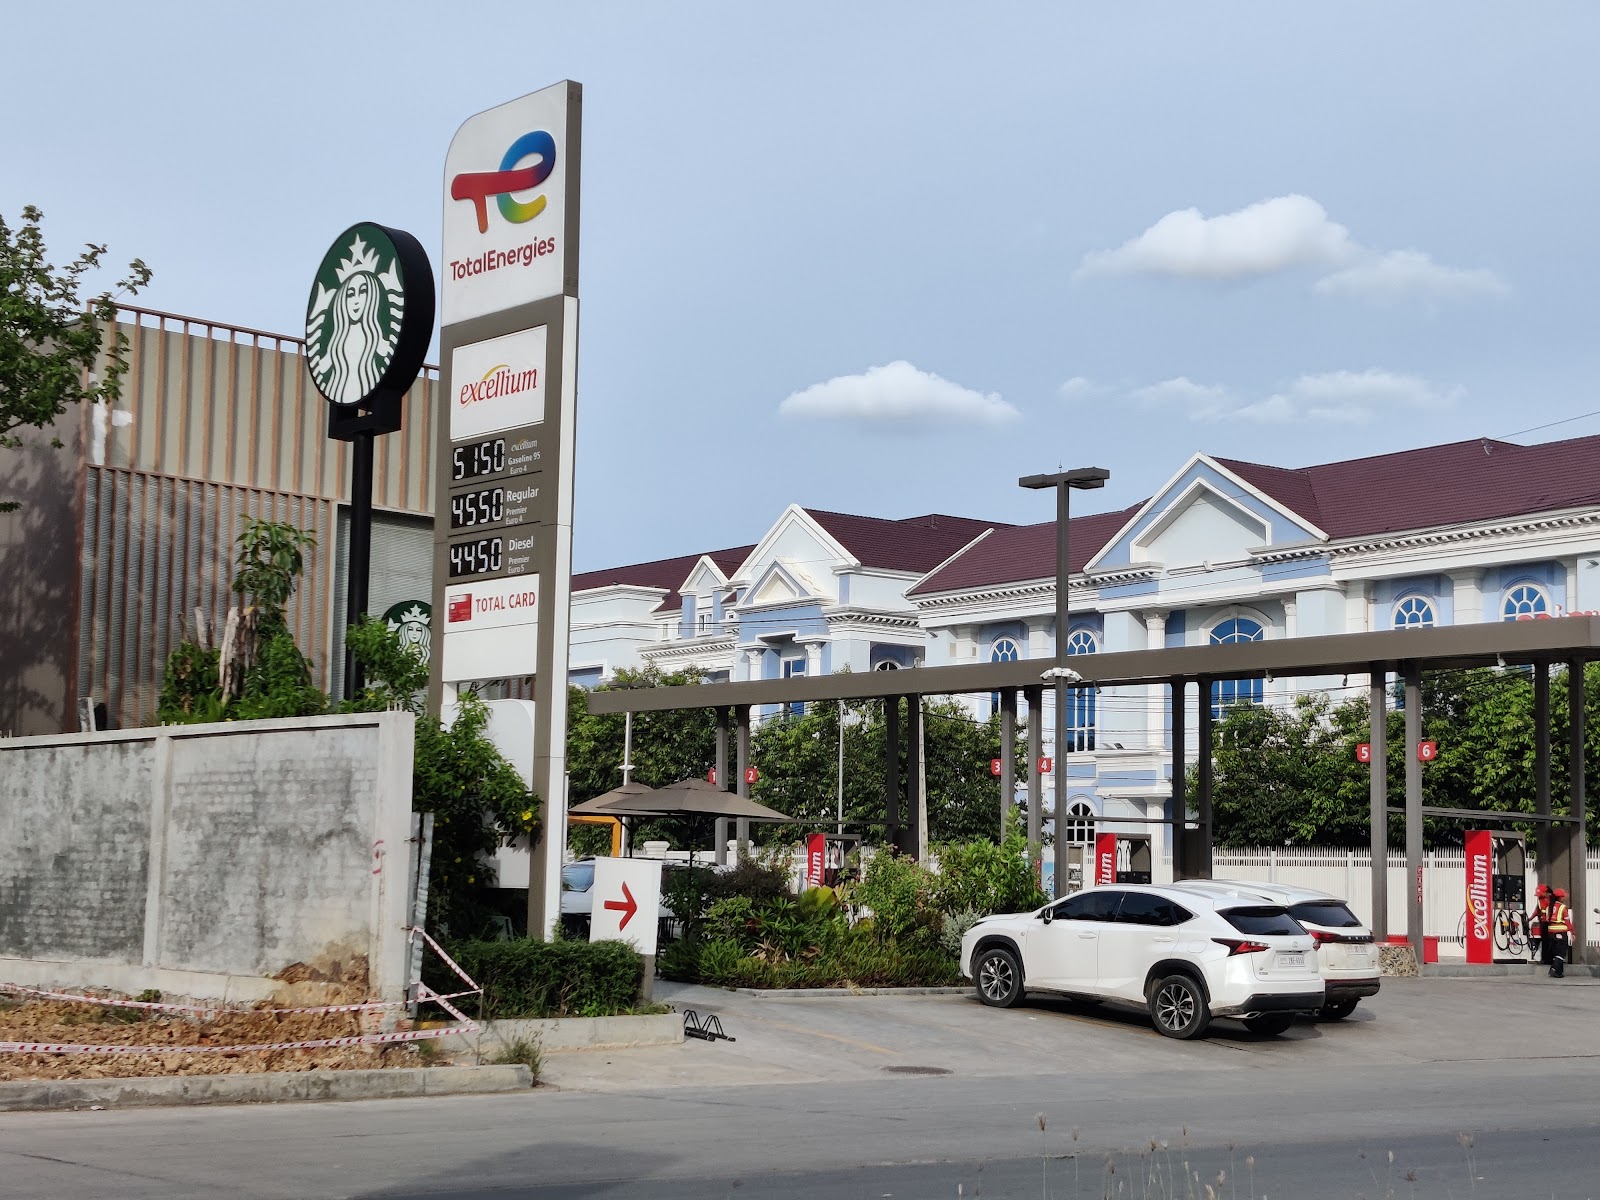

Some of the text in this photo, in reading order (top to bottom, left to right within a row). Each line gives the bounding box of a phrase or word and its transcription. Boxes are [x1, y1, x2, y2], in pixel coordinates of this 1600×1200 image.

[450, 236, 555, 281] TotalEnergies
[460, 368, 537, 405] excellium
[453, 439, 505, 480] 5150
[507, 451, 541, 466] Gasoline 95
[509, 466, 523, 475] Euro
[506, 486, 540, 504] Regular
[452, 488, 504, 526] 4550
[505, 506, 528, 517] Premier
[505, 516, 519, 525] Euro
[508, 535, 534, 551] Diesel
[450, 538, 503, 574] 4450
[508, 555, 530, 565] Premier
[507, 563, 525, 574] Euro 5
[475, 591, 536, 613] TOTAL CARD
[1361, 747, 1369, 759] 5
[1422, 744, 1430, 757] 6
[994, 761, 1001, 772] 3
[1041, 760, 1048, 771] 4
[712, 771, 716, 782] 1
[748, 770, 754, 781] 2
[1470, 854, 1489, 940] excellium
